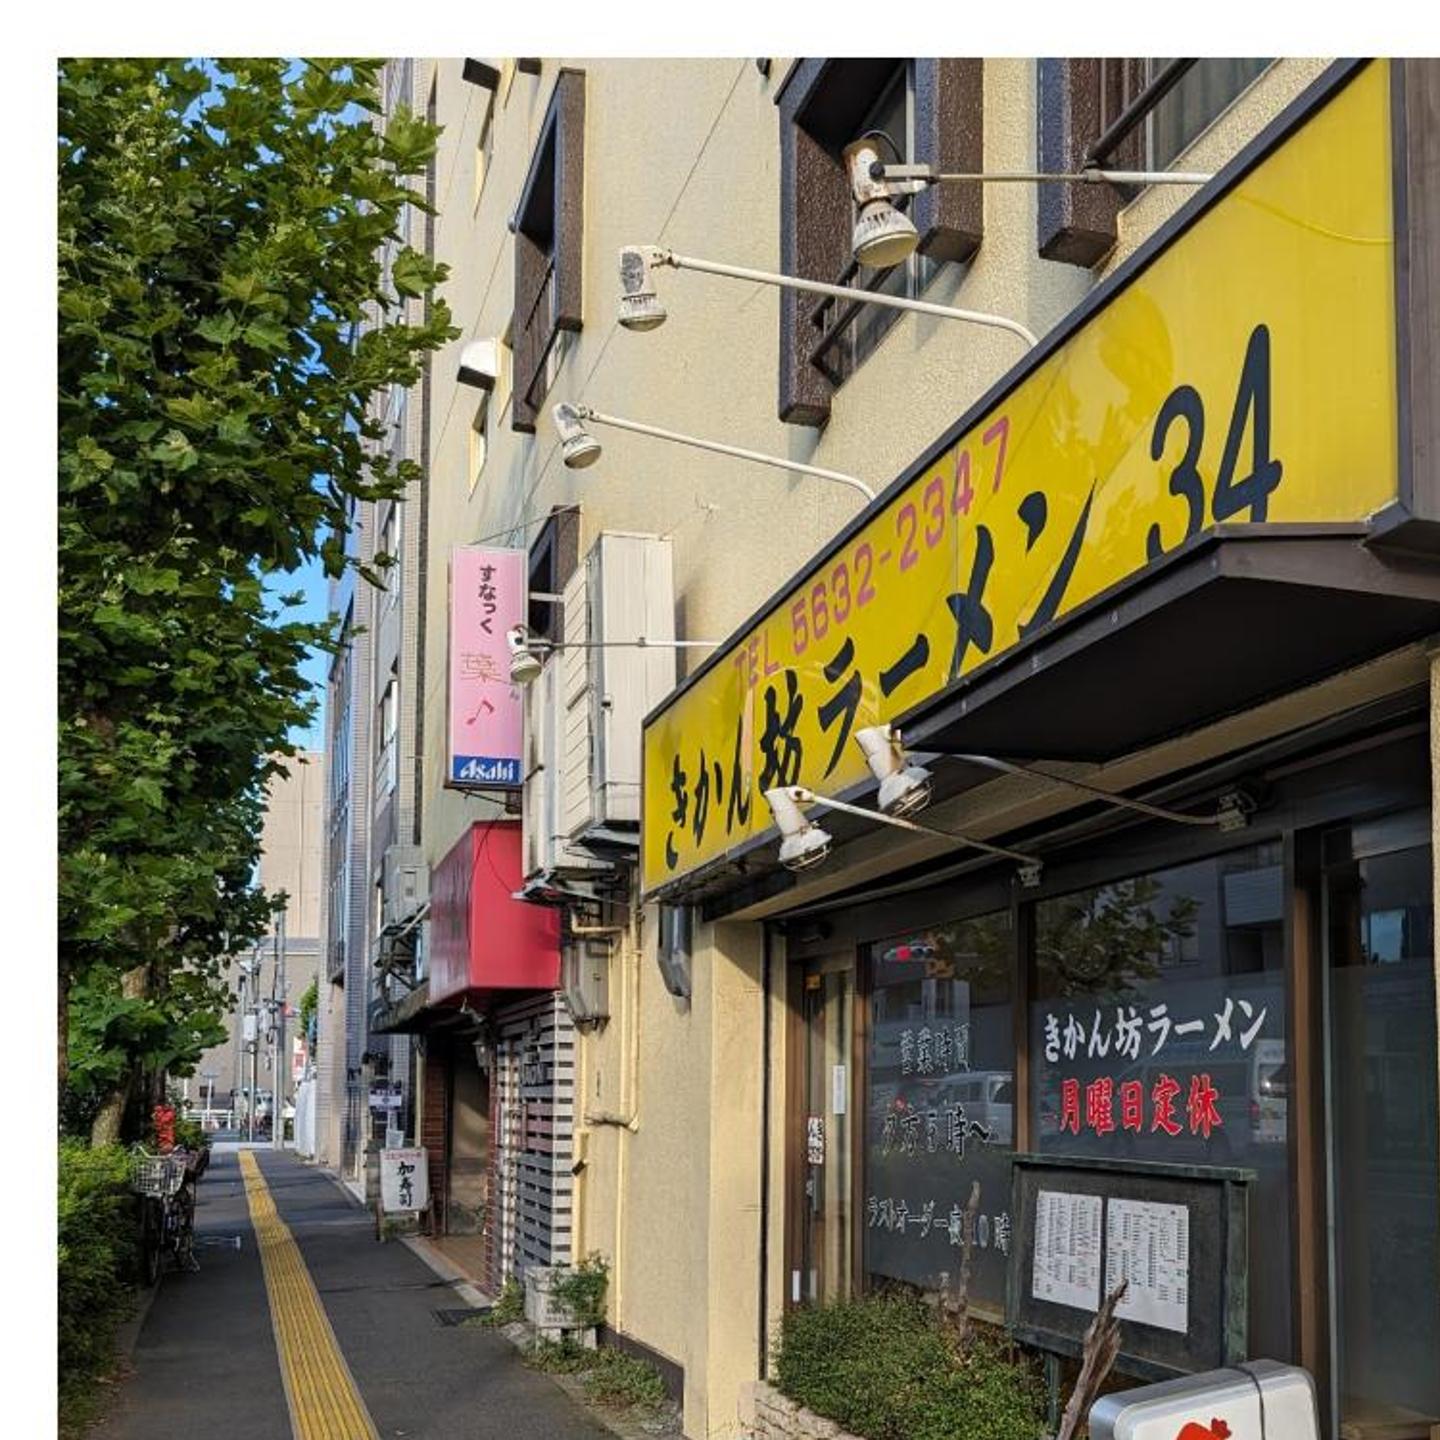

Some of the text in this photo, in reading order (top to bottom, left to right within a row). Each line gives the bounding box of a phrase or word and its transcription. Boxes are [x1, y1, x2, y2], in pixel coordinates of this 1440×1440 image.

[1146, 323, 1283, 563] 34
[735, 416, 1012, 684] TEL 5632-2347
[479, 563, 498, 635] すなっく
[666, 477, 1098, 869] きかん坊ラーメン
[460, 761, 514, 780] Asahi
[1043, 997, 1268, 1063] きかん坊ラーメン
[1058, 1074, 1224, 1139] 月曜日定休
